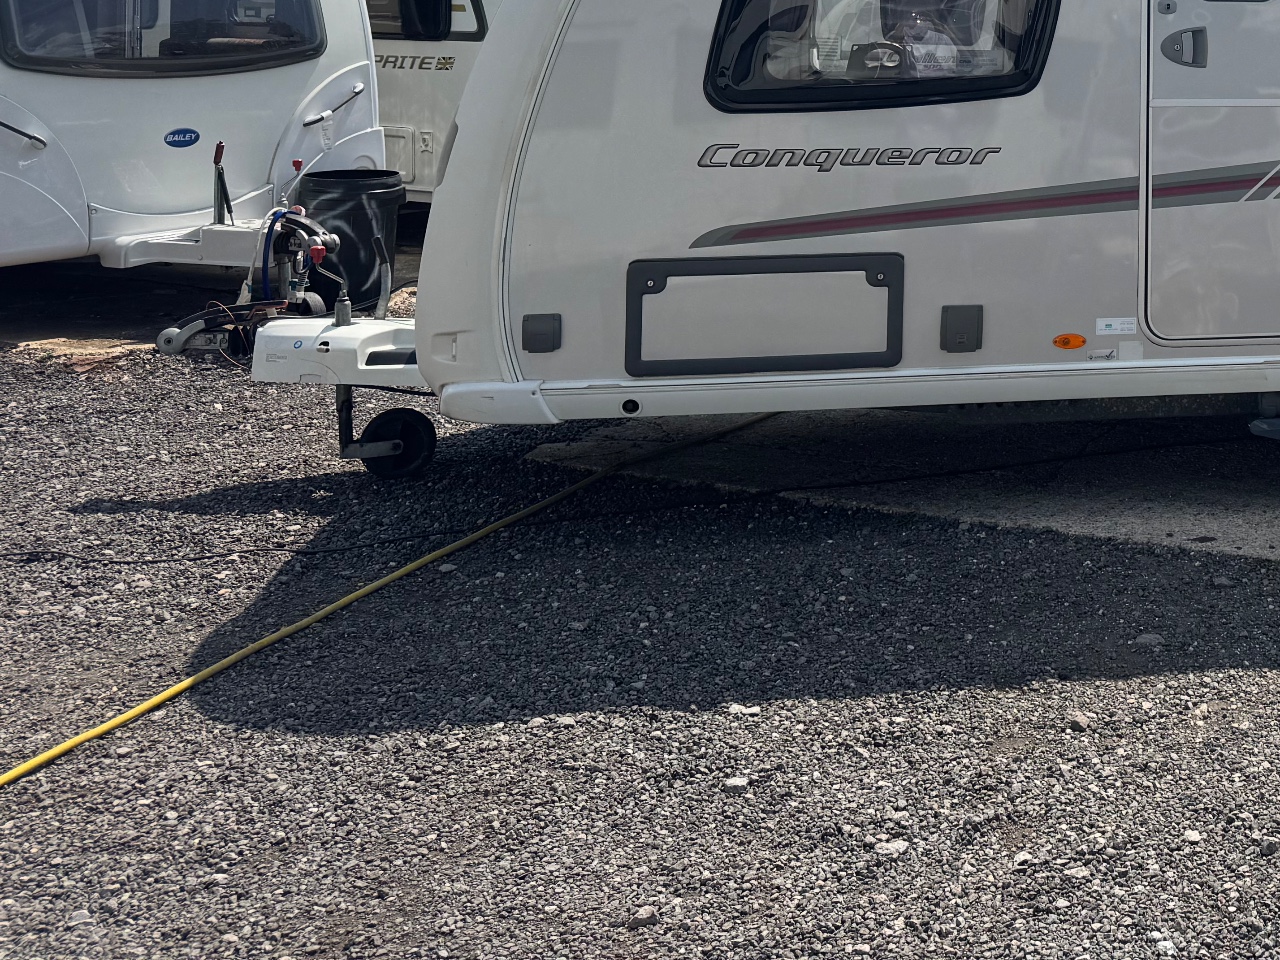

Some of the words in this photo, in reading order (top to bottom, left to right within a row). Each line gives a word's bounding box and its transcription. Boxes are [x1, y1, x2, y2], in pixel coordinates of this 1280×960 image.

[374, 54, 436, 70] PRITE
[166, 133, 197, 142] BAILEY
[697, 143, 1002, 172] Conqueror
